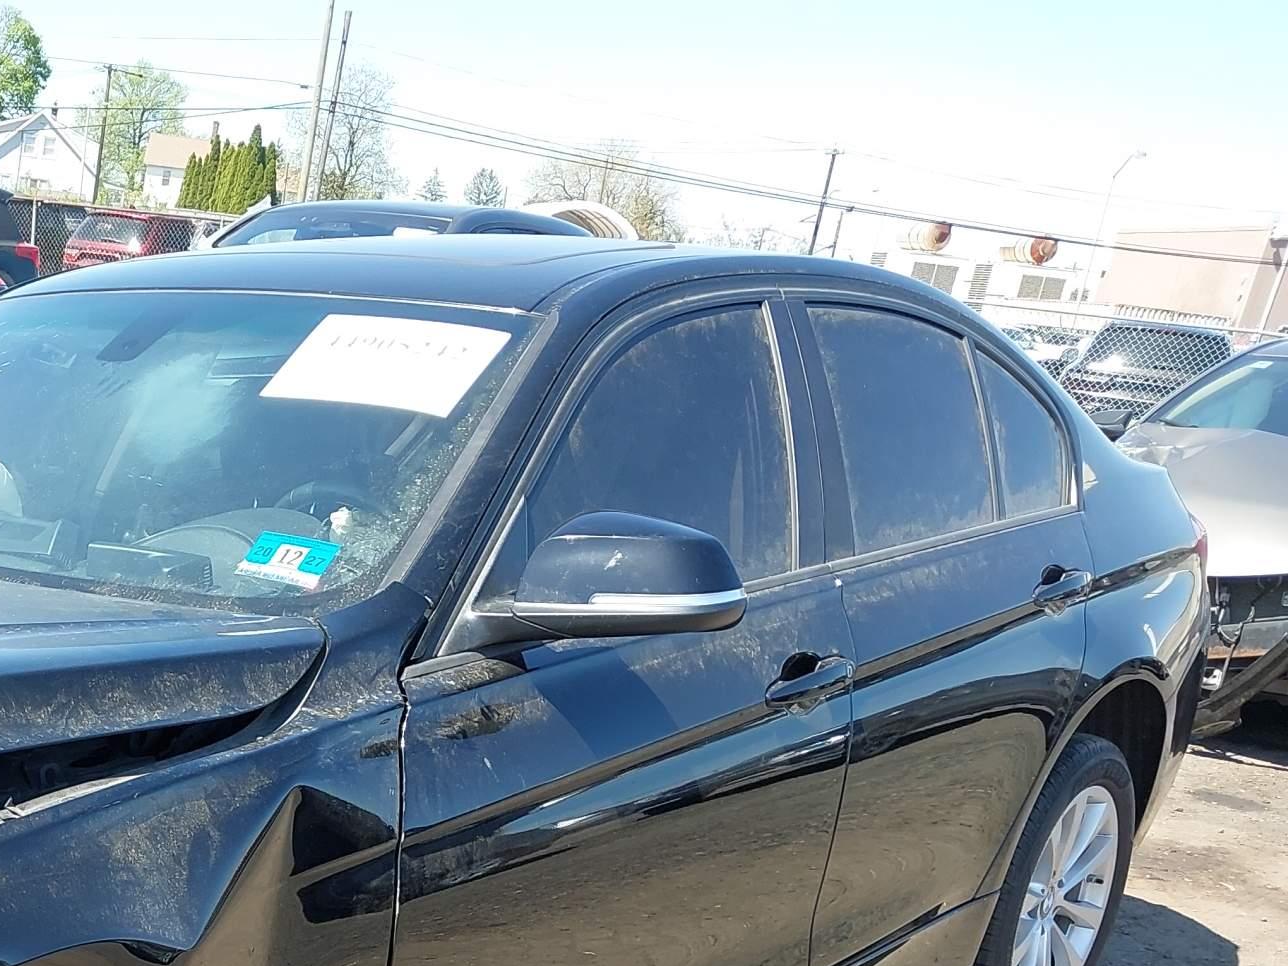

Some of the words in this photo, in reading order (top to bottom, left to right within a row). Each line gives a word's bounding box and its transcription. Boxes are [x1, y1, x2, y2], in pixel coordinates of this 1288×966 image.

[254, 545, 273, 557] 20
[277, 548, 304, 566] 12
[306, 556, 327, 567] 27
